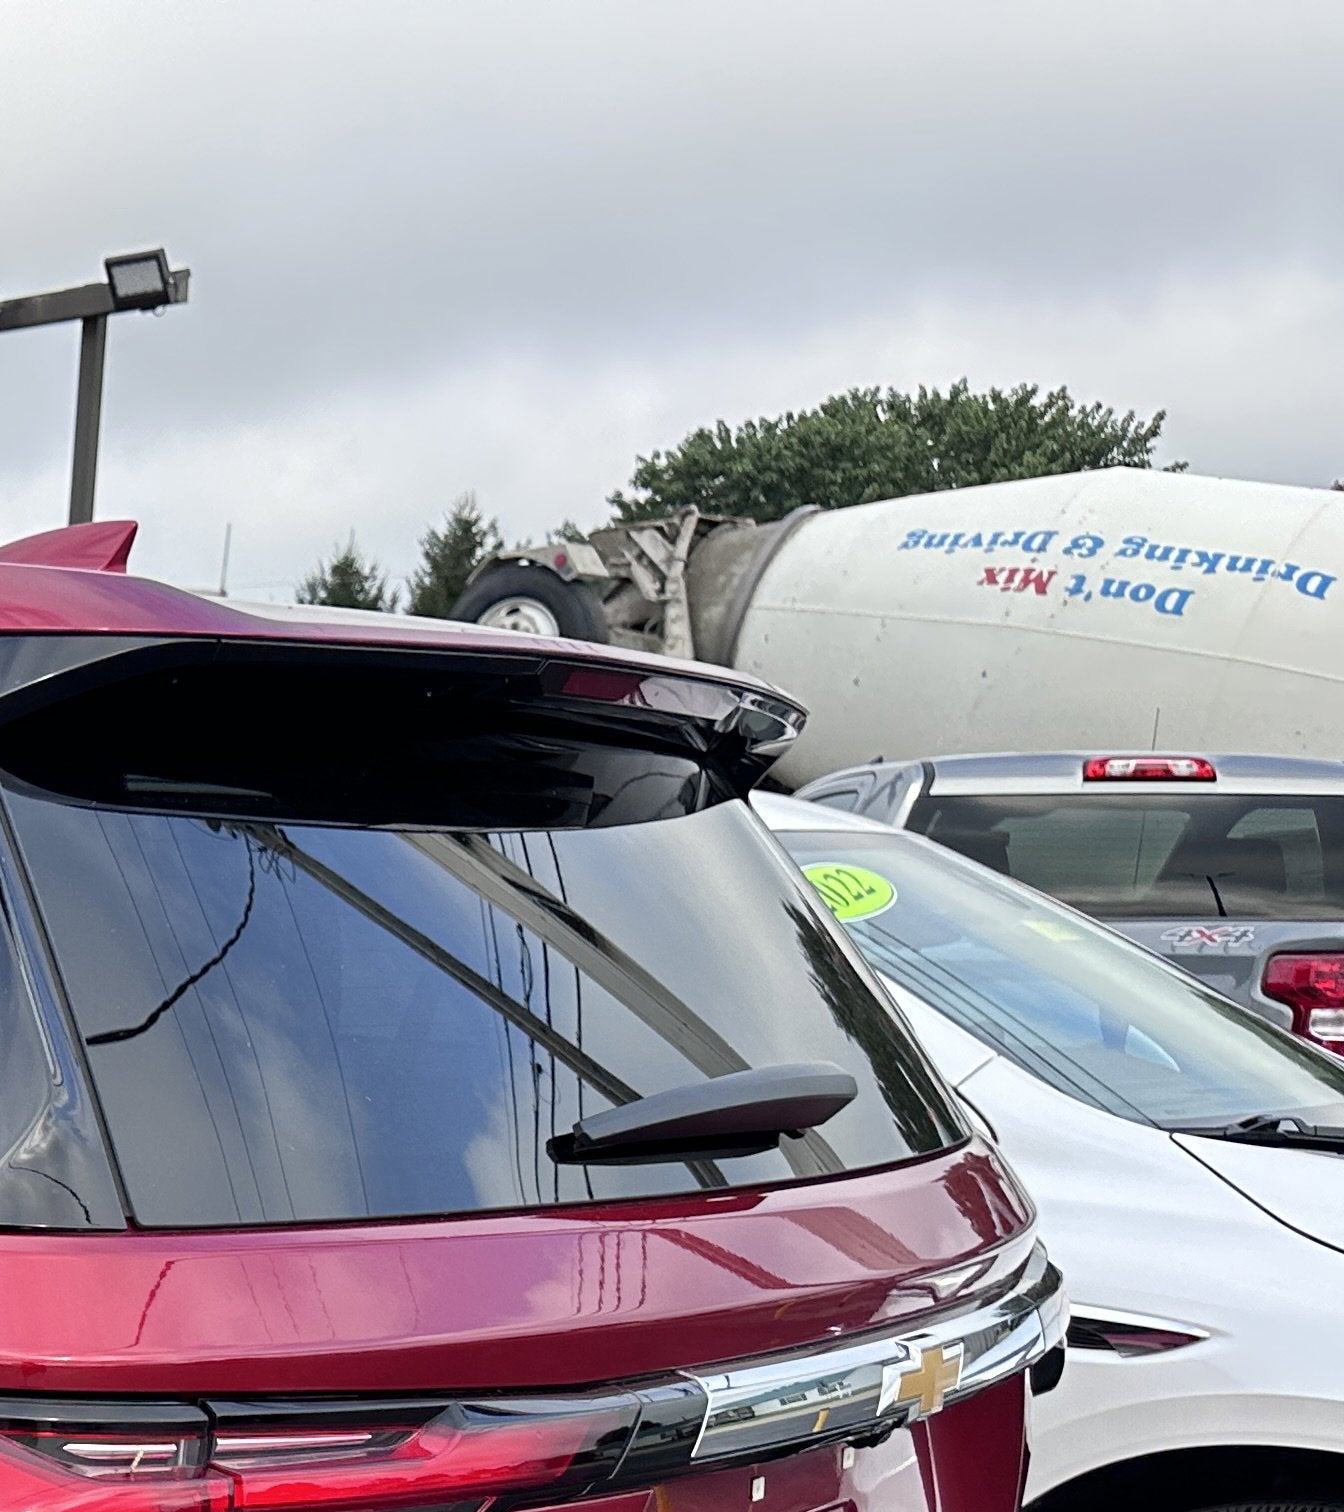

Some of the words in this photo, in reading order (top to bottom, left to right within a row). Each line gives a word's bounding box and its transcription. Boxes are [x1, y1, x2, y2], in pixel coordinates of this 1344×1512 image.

[897, 528, 1059, 554] Driving
[1063, 534, 1105, 558] &
[977, 566, 1057, 596] Mix
[1114, 535, 1337, 600] Drinking
[1064, 574, 1195, 616] Don't
[813, 869, 877, 913] 022
